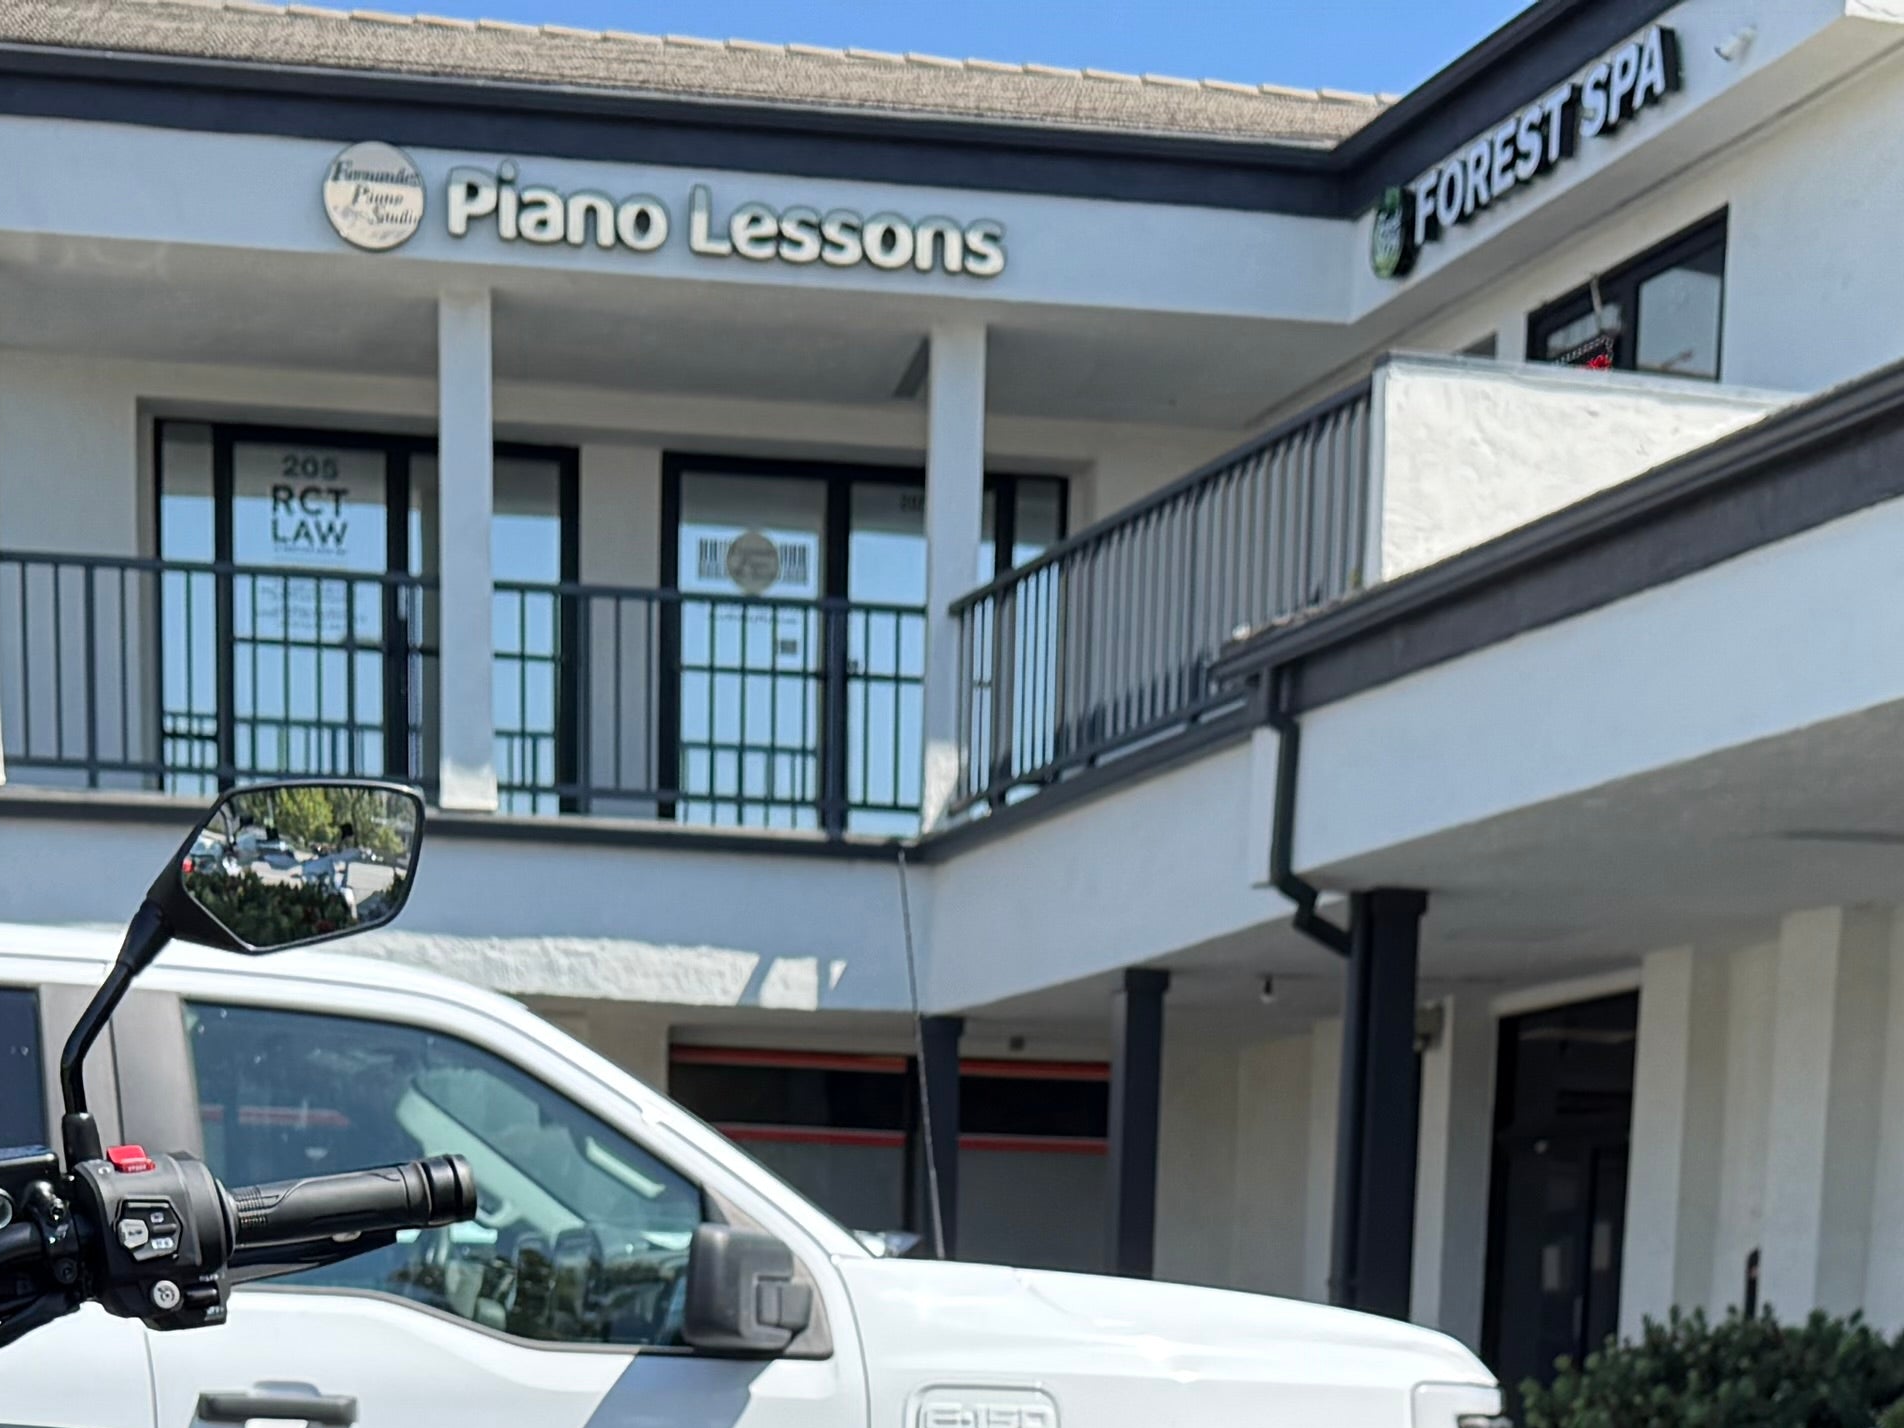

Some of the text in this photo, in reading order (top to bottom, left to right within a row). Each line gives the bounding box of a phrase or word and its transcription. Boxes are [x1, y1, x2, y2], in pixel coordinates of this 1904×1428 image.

[1414, 82, 1575, 246] FOREST
[1579, 25, 1676, 138] SPA
[446, 159, 1007, 276] Piano Lessons
[282, 454, 340, 480] 205
[272, 484, 350, 517] RCT
[271, 516, 347, 547] LAW
